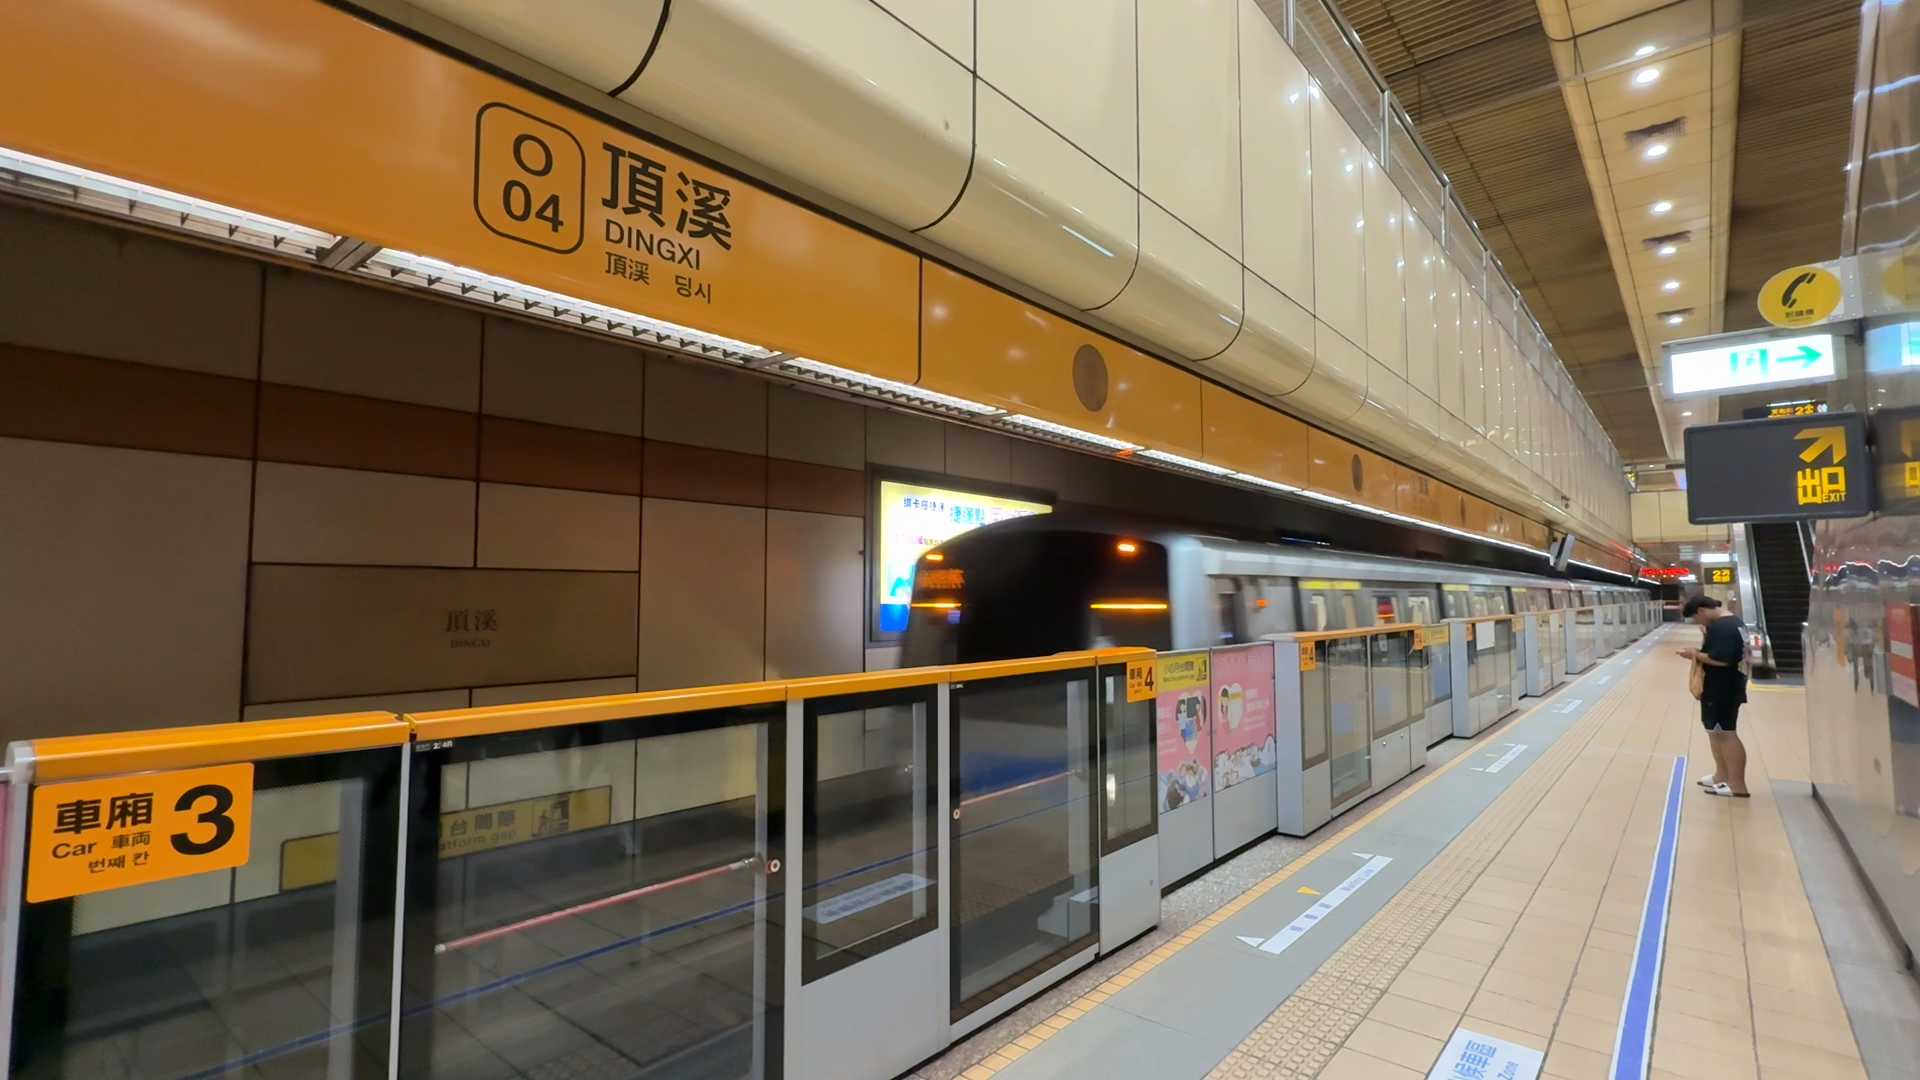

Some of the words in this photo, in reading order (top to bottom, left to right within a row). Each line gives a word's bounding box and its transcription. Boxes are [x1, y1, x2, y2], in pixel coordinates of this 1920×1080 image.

[513, 133, 553, 177] O
[502, 179, 564, 233] 04
[602, 141, 732, 251] 頂溪
[605, 219, 700, 270] DINGXI
[675, 274, 711, 304] 딩시
[1797, 466, 1846, 505] 出口
[1822, 491, 1847, 503] EXIT
[445, 609, 498, 632] 頂溪
[450, 639, 490, 648] DINGXI
[1145, 666, 1154, 691] 4
[53, 792, 154, 835] 車廂
[170, 784, 235, 856] 3
[52, 842, 97, 859] Car
[111, 831, 151, 849] 車両
[491, 829, 517, 844] gap
[88, 854, 126, 874] 번째
[132, 851, 150, 866] 칸
